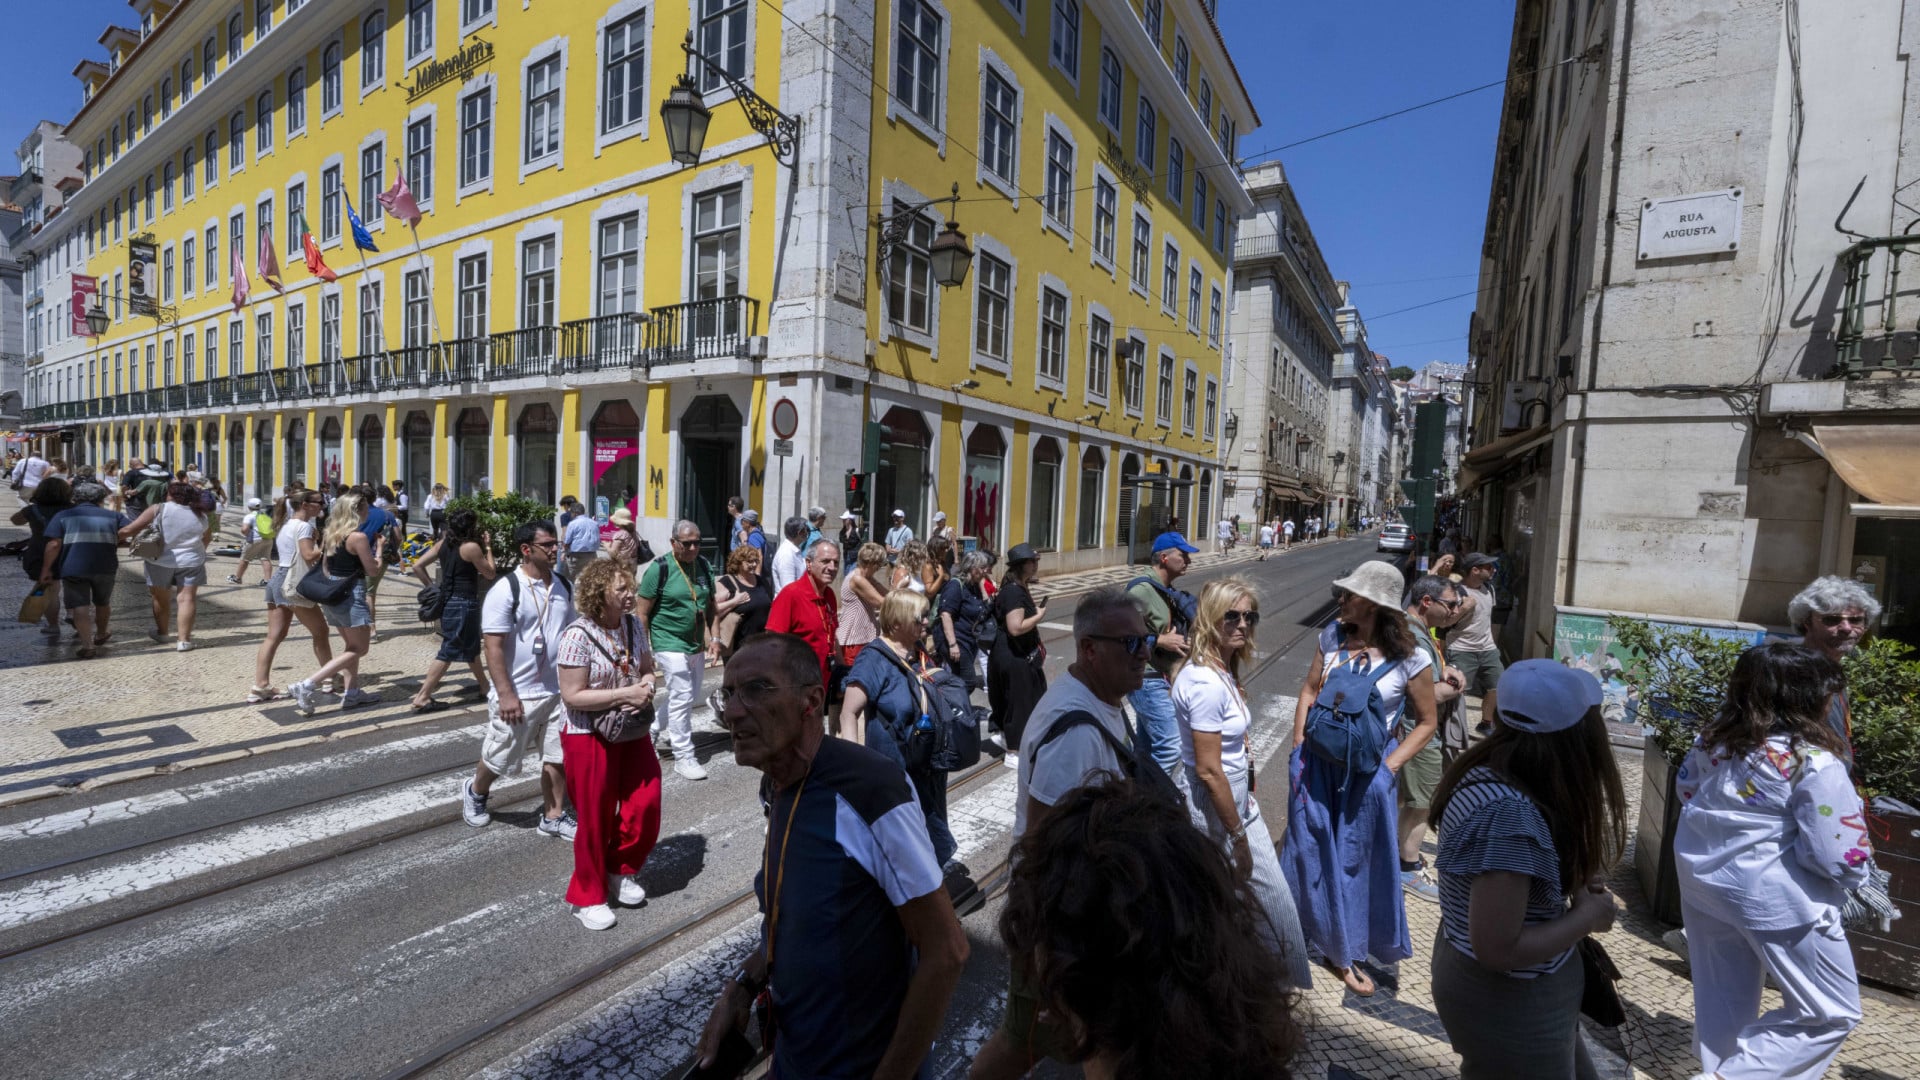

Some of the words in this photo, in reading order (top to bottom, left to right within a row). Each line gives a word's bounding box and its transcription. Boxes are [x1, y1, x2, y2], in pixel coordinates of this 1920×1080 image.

[416, 42, 484, 92] Millennium
[1679, 213, 1704, 222] RUA
[1662, 226, 1716, 239] AUGUSTA
[1558, 629, 1584, 640] Vida
